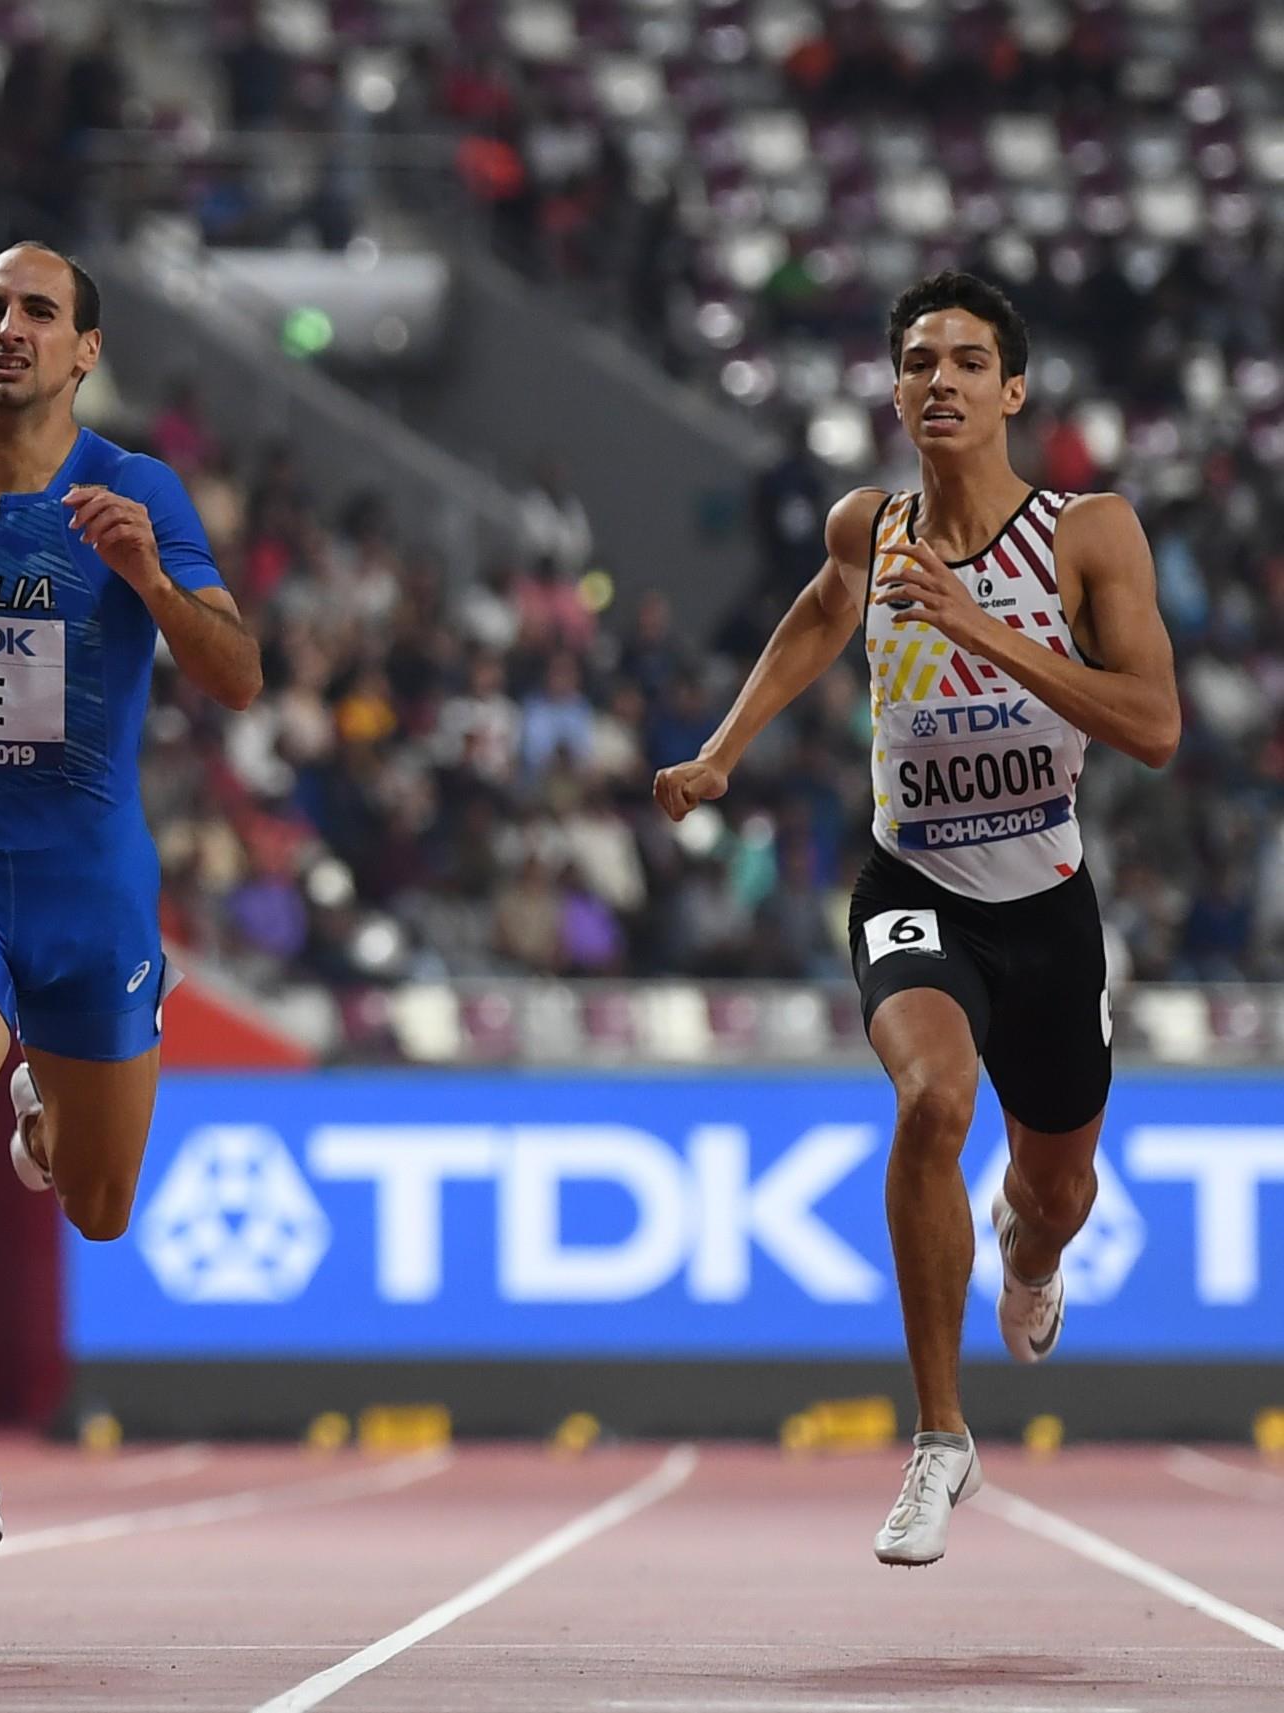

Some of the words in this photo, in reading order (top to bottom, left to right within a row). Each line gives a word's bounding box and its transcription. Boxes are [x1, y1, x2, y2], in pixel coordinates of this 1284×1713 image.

[936, 699, 1033, 735] TDK
[899, 744, 1056, 809] SACOOR
[925, 808, 1047, 846] DOHA2019
[888, 915, 926, 945] 6
[308, 1124, 884, 1302] TDK
